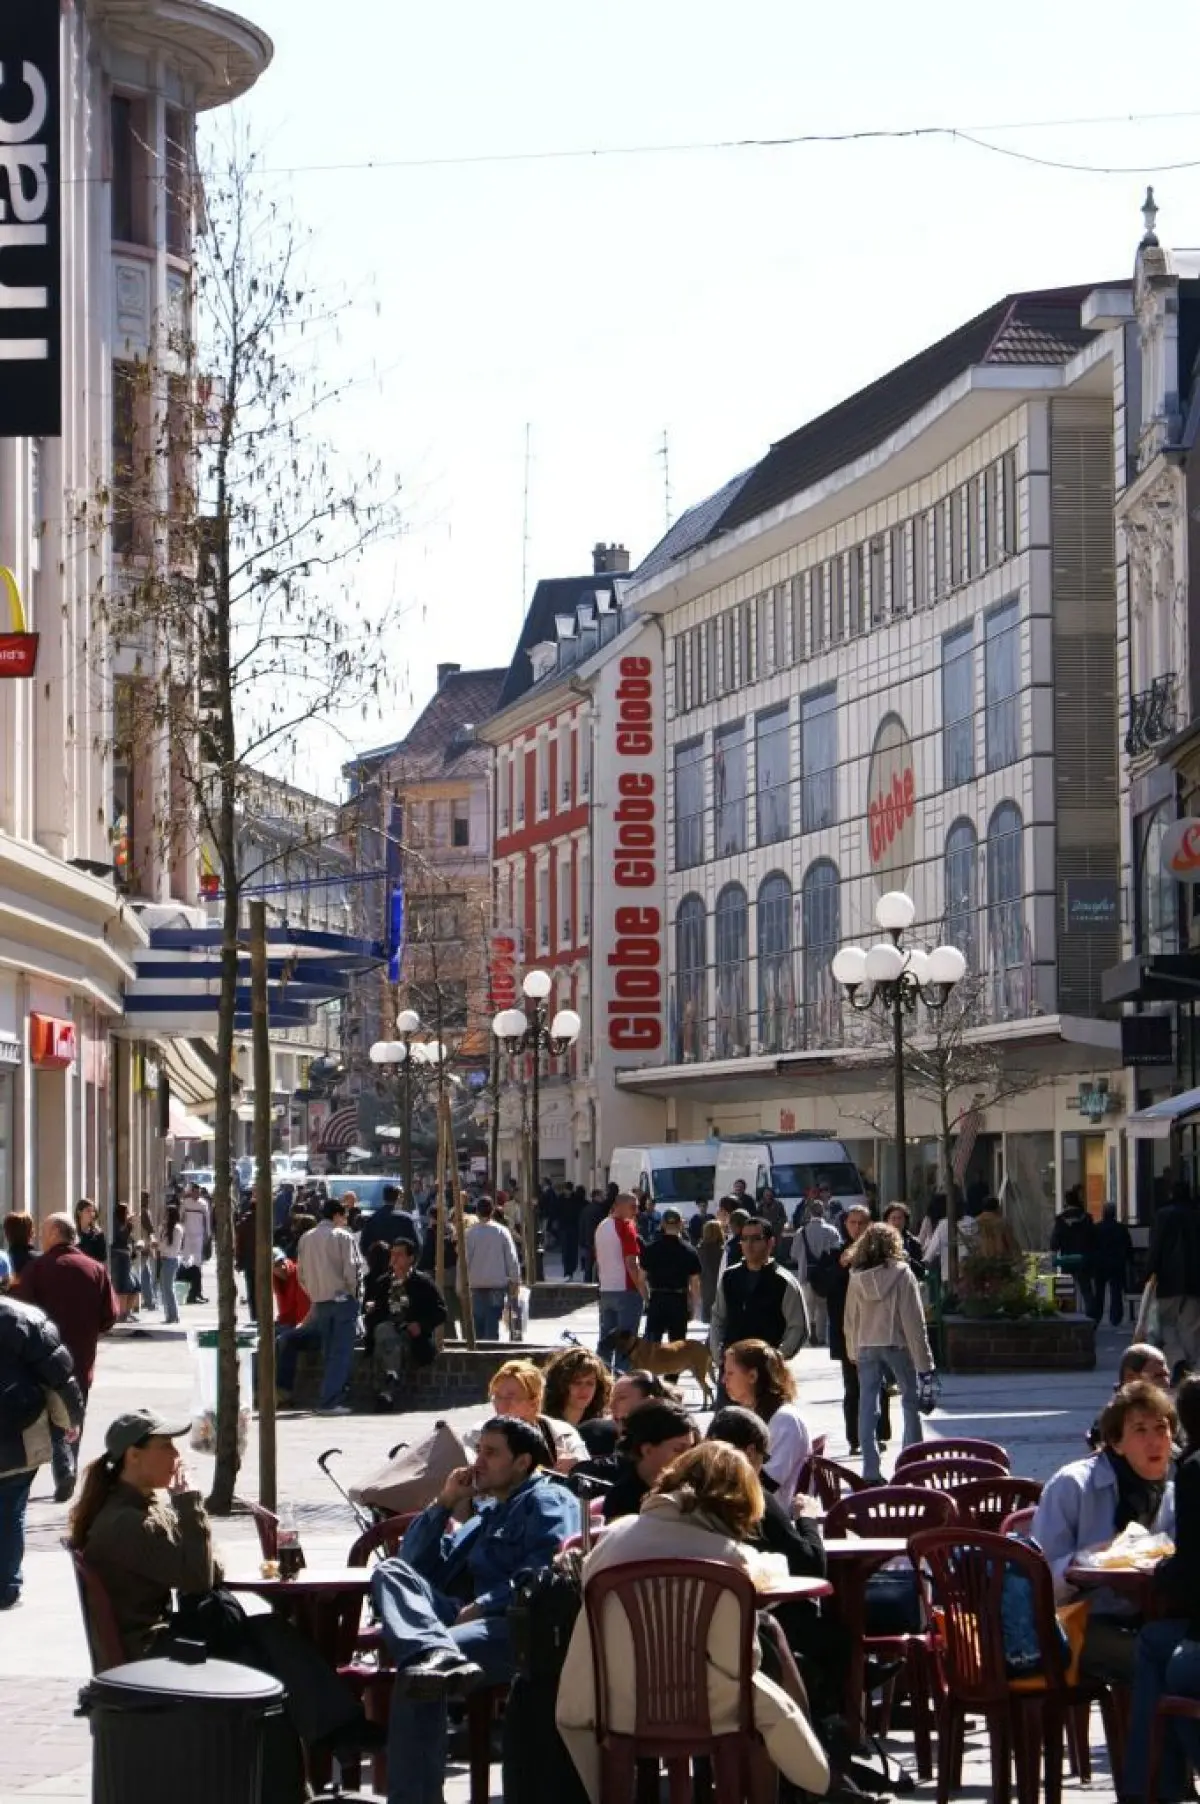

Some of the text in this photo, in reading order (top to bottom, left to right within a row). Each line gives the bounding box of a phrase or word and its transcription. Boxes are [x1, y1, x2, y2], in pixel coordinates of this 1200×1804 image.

[607, 656, 661, 1050] Globe Globe Globe
[869, 767, 914, 862] Globe
